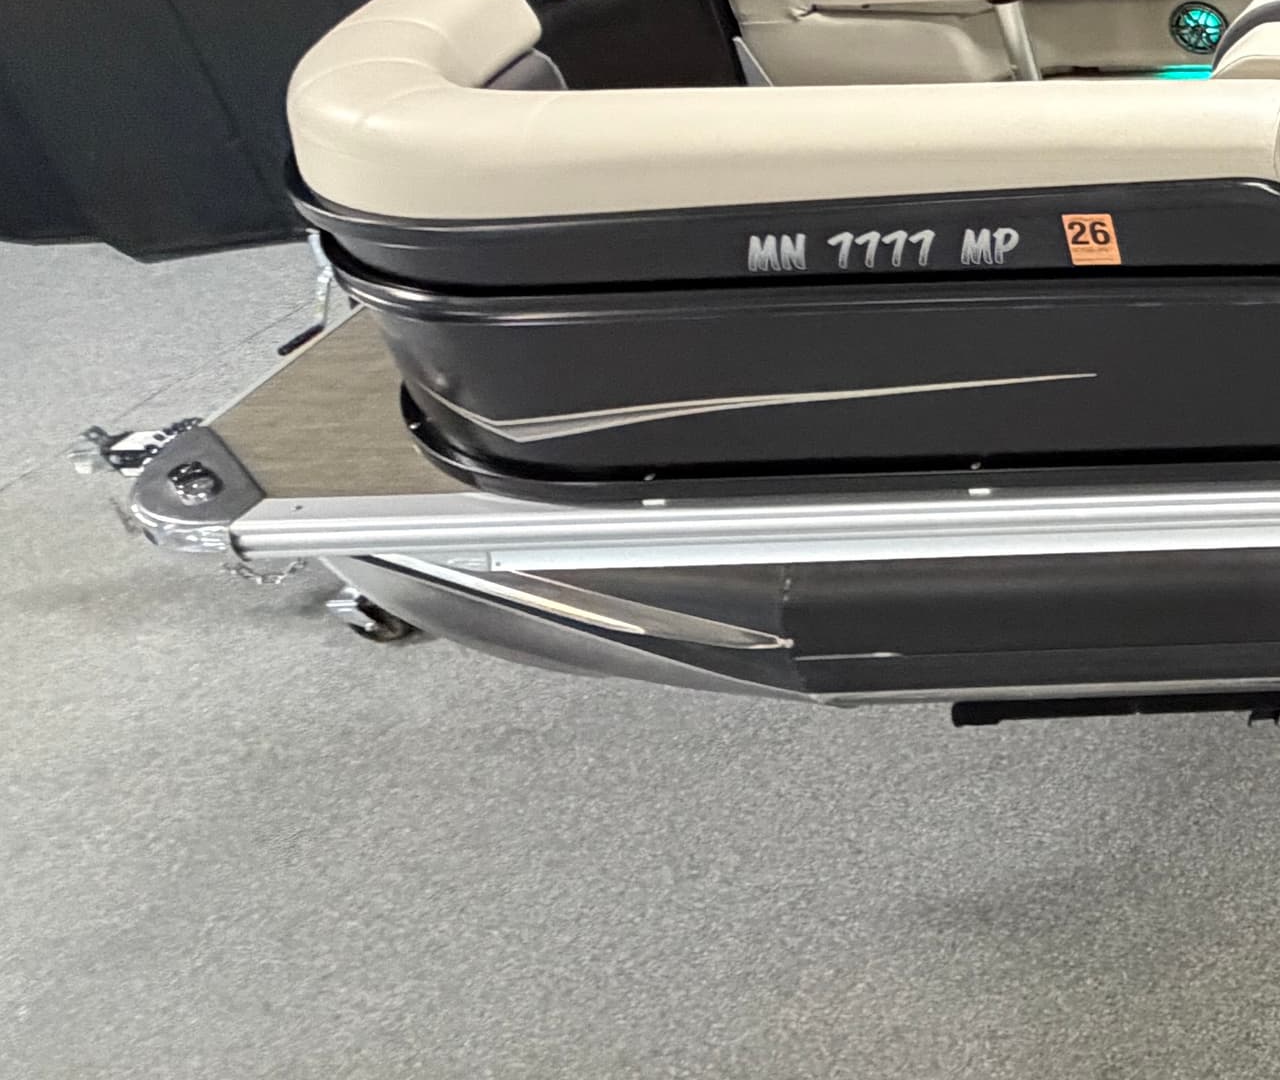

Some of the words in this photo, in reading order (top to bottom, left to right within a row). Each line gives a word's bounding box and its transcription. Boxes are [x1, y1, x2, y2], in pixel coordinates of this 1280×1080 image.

[748, 233, 807, 271] MN
[960, 227, 1020, 265] MP
[1067, 221, 1111, 246] 26
